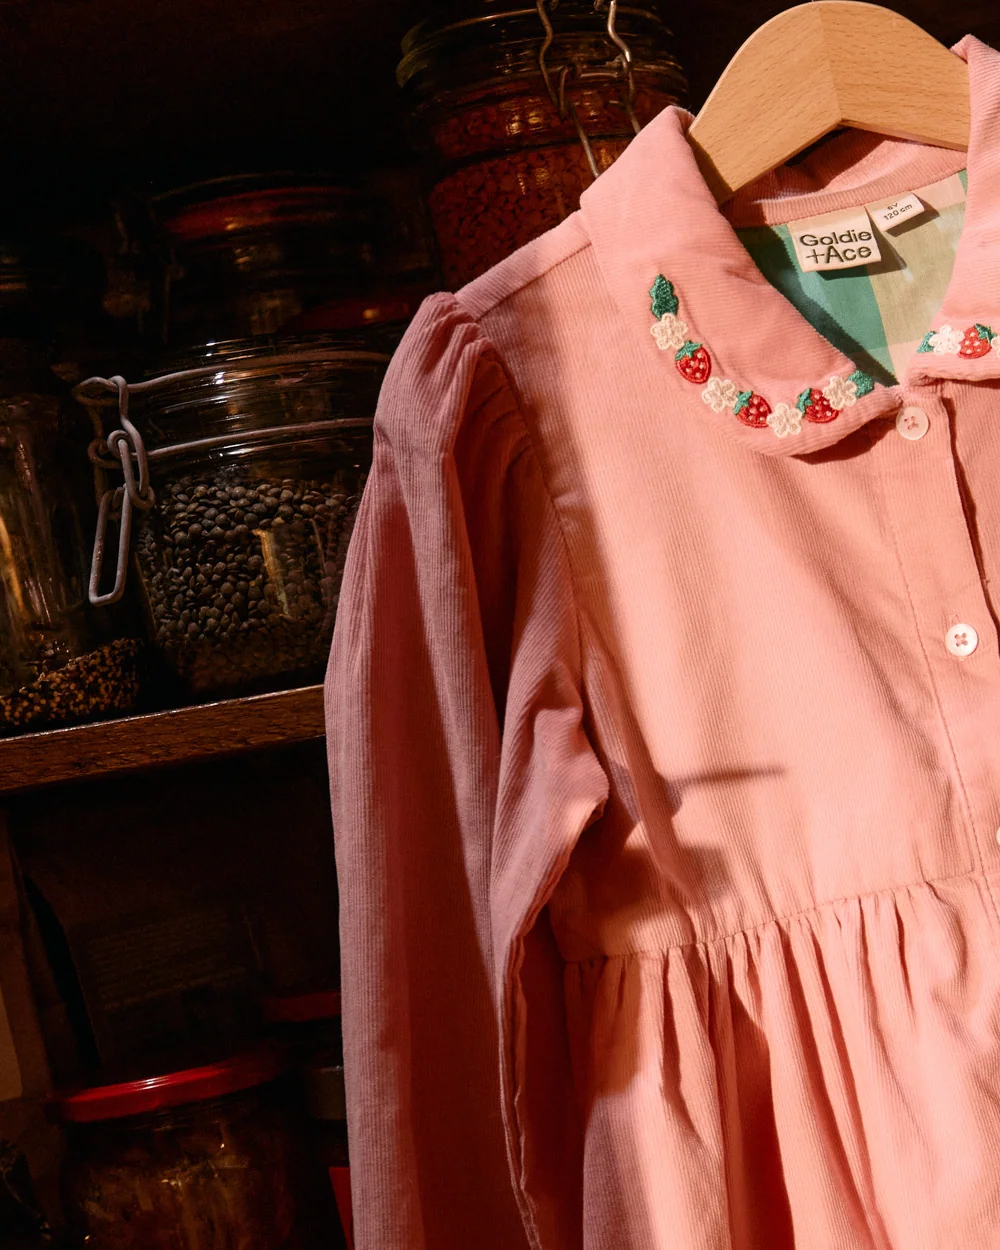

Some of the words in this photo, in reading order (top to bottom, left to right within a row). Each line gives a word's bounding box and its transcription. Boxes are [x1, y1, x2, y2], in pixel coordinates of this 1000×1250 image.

[883, 210, 899, 221] 120
[900, 203, 913, 213] cm
[800, 229, 872, 247] Goldie
[806, 245, 872, 264] +Ace
